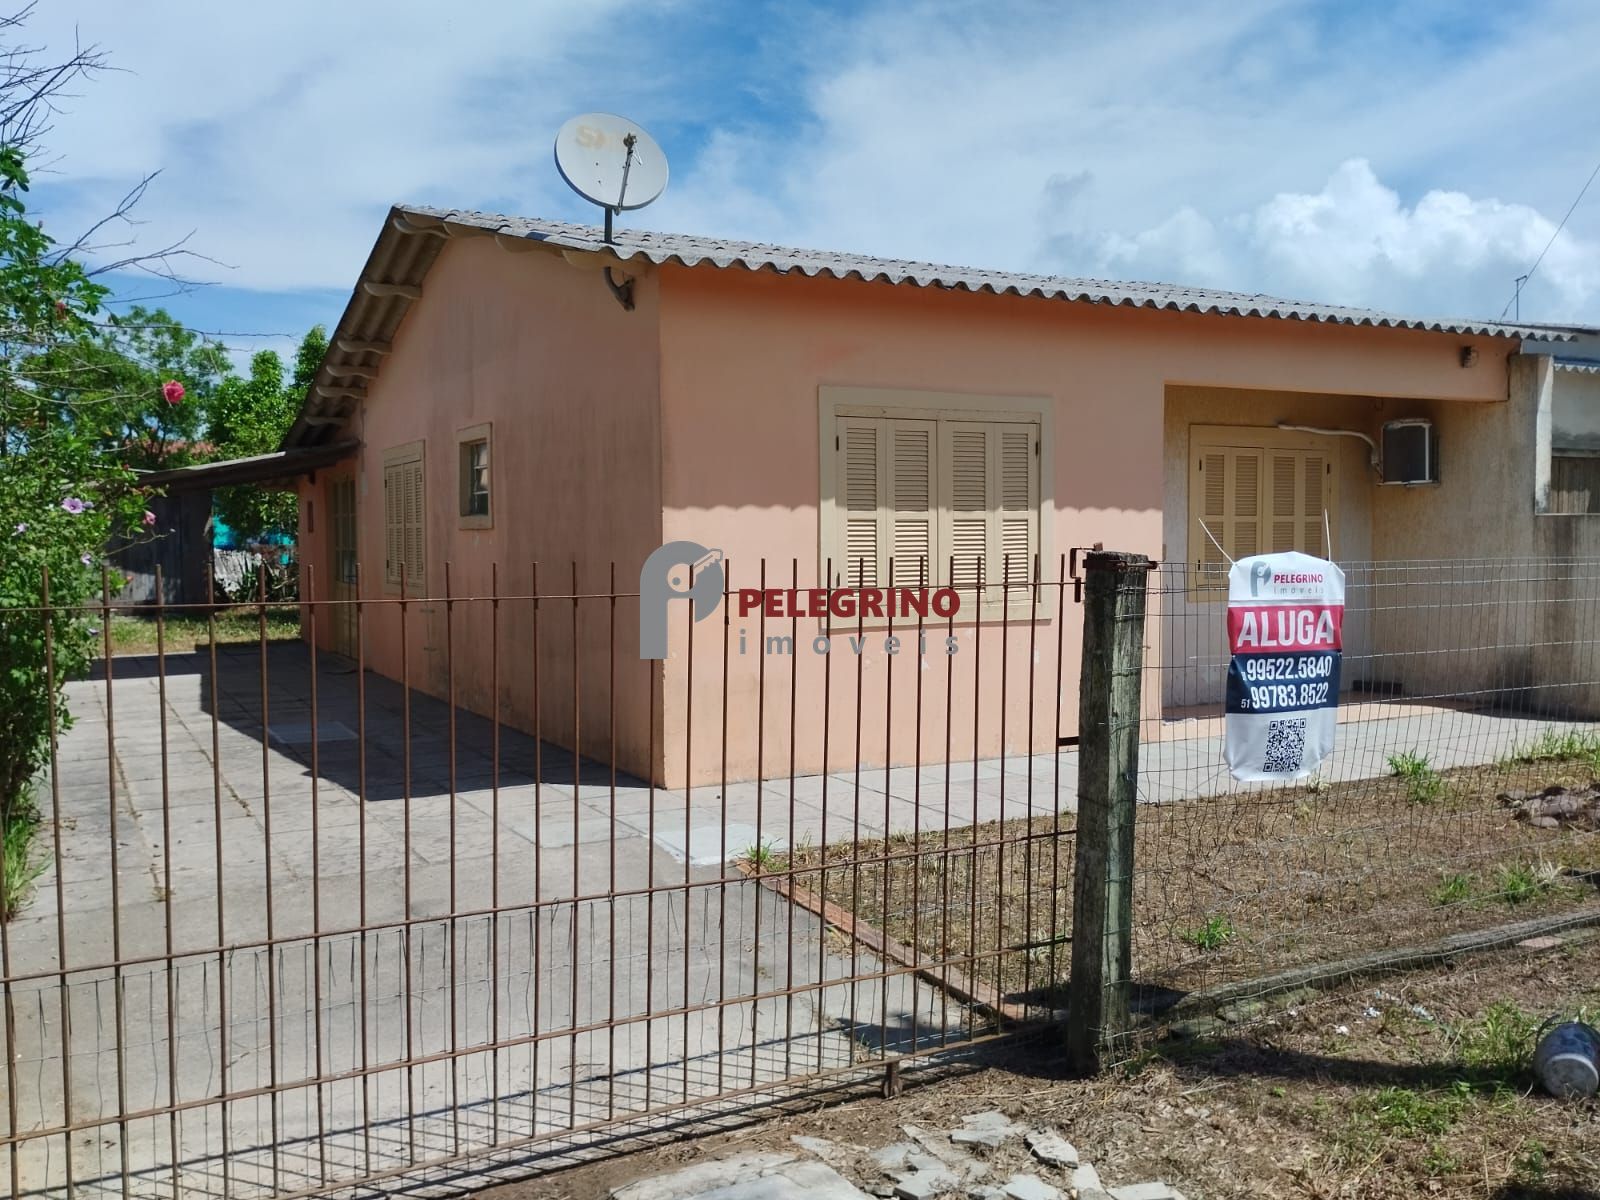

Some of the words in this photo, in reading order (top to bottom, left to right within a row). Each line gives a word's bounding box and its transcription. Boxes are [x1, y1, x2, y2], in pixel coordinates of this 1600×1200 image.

[1273, 574, 1323, 584] PELEGRINO
[1237, 609, 1335, 648] ALUGA
[1246, 655, 1333, 681] 99522.5840
[1240, 698, 1250, 709] 51
[1250, 681, 1329, 709] 99783.8522
